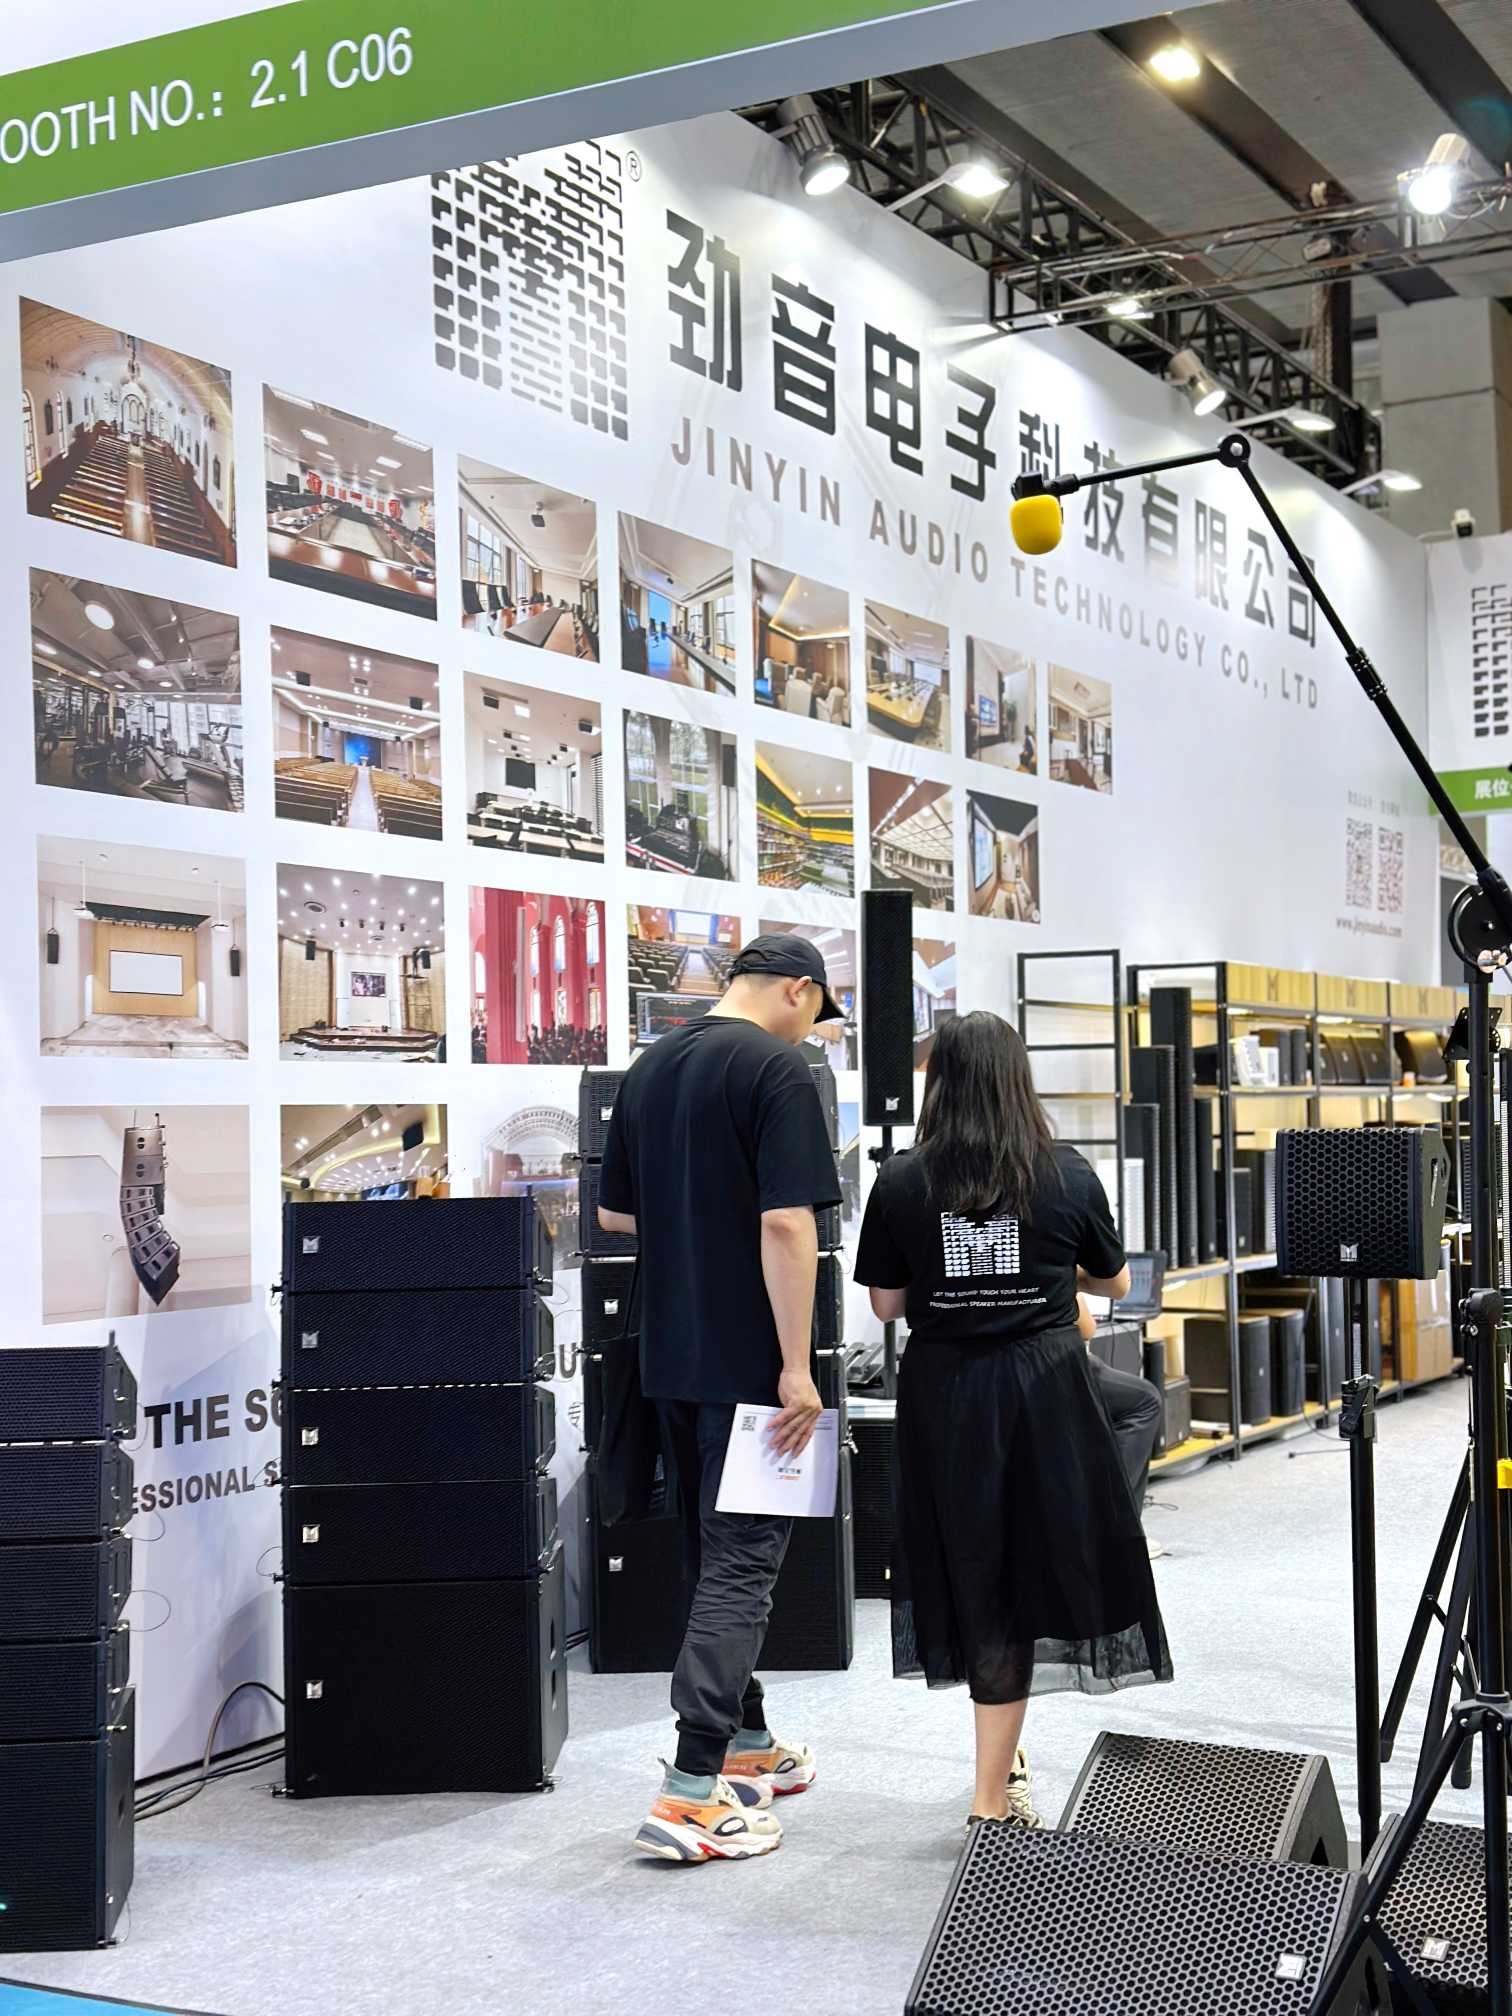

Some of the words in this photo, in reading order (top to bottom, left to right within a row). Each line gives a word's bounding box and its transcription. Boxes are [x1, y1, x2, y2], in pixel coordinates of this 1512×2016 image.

[250, 49, 308, 108] 2.1
[327, 26, 413, 89] C06
[670, 416, 841, 526] JINYIN
[869, 499, 989, 584] AUDIO
[1010, 556, 1206, 668] TECHNOLOGY
[1281, 667, 1318, 710] LTD
[144, 1394, 230, 1449] THE
